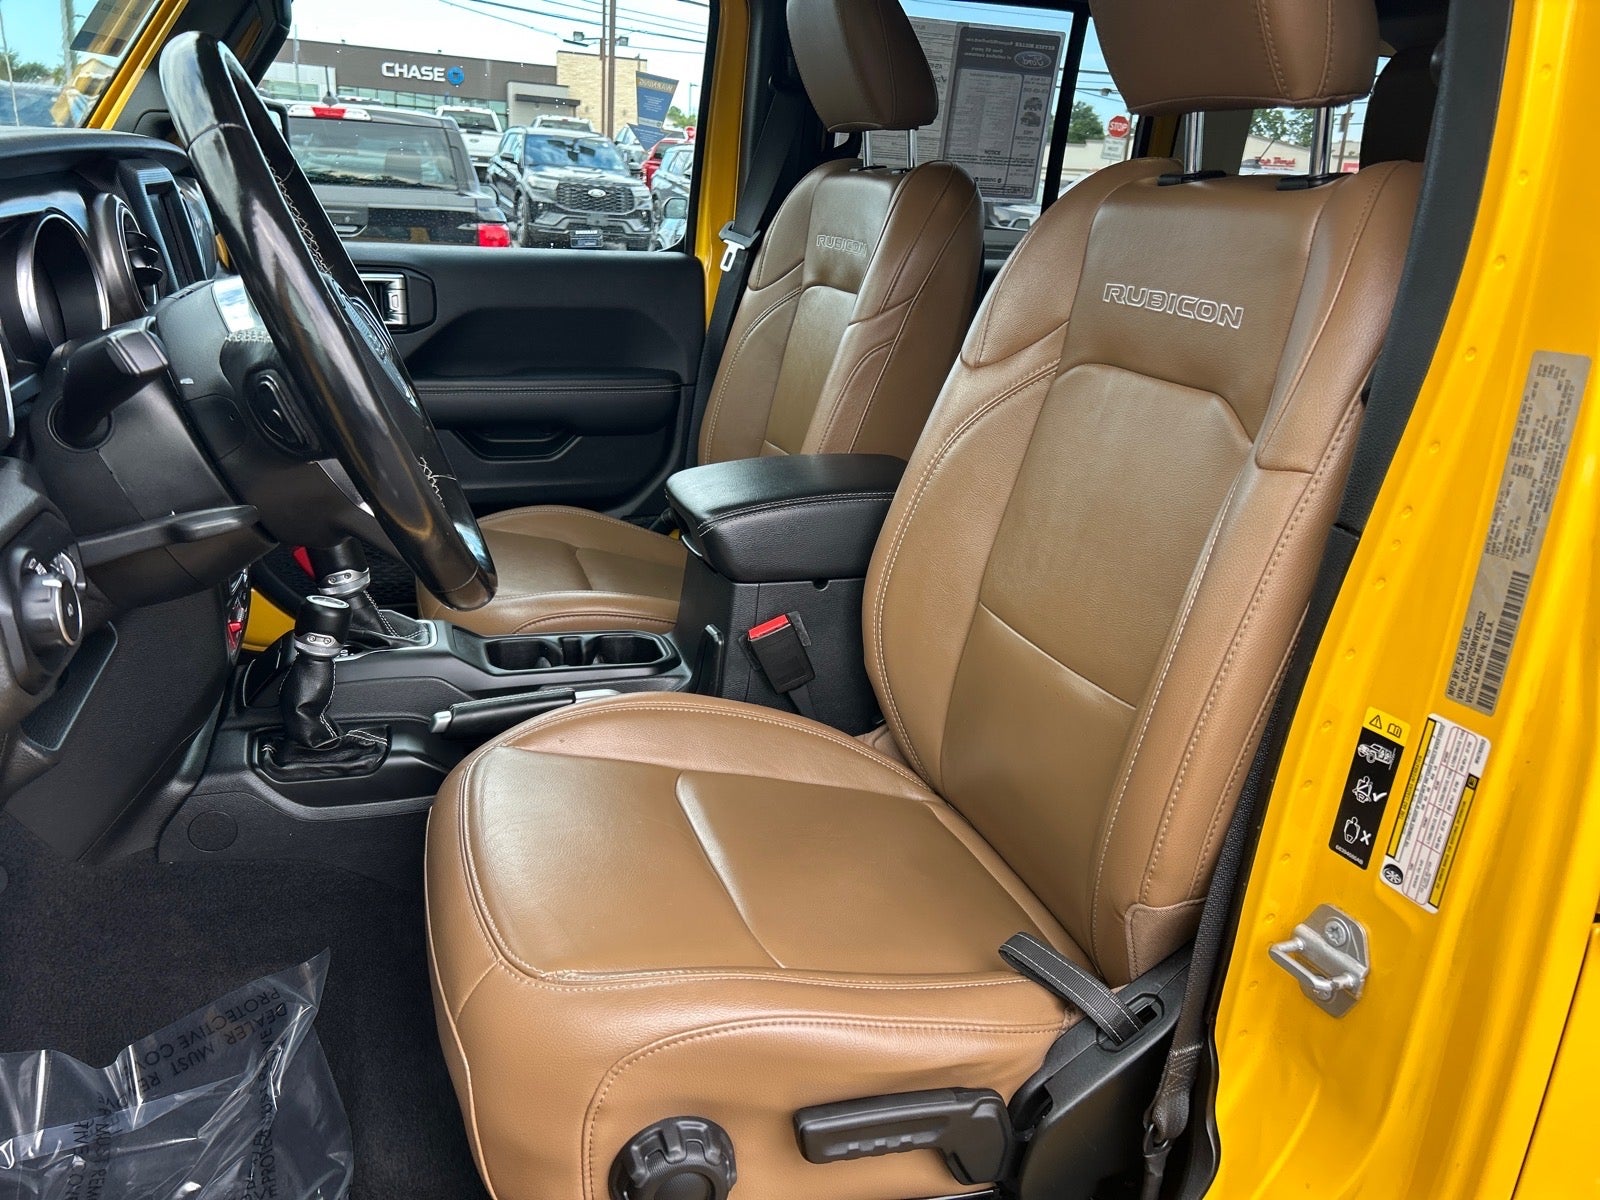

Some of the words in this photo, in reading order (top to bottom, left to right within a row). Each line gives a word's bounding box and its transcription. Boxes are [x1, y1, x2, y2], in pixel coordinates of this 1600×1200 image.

[381, 62, 446, 82] CHASE
[1110, 121, 1128, 131] STOP
[816, 234, 867, 257] RUBICON
[1102, 283, 1244, 329] RUBICON
[1462, 625, 1471, 639] LLC
[1482, 618, 1494, 641] U.S.A.
[1459, 639, 1468, 650] US
[1479, 641, 1487, 653] IN:
[1455, 651, 1464, 665] FCA
[1473, 653, 1484, 674] MADE
[1452, 666, 1460, 679] BY:
[1447, 679, 1457, 696] MFD
[1456, 684, 1465, 700] VIN:
[1465, 675, 1478, 704] VEHICLE
[177, 986, 280, 1051] PROTECTIVE
[224, 1001, 288, 1046] DEALER
[172, 1041, 220, 1077] MUST
